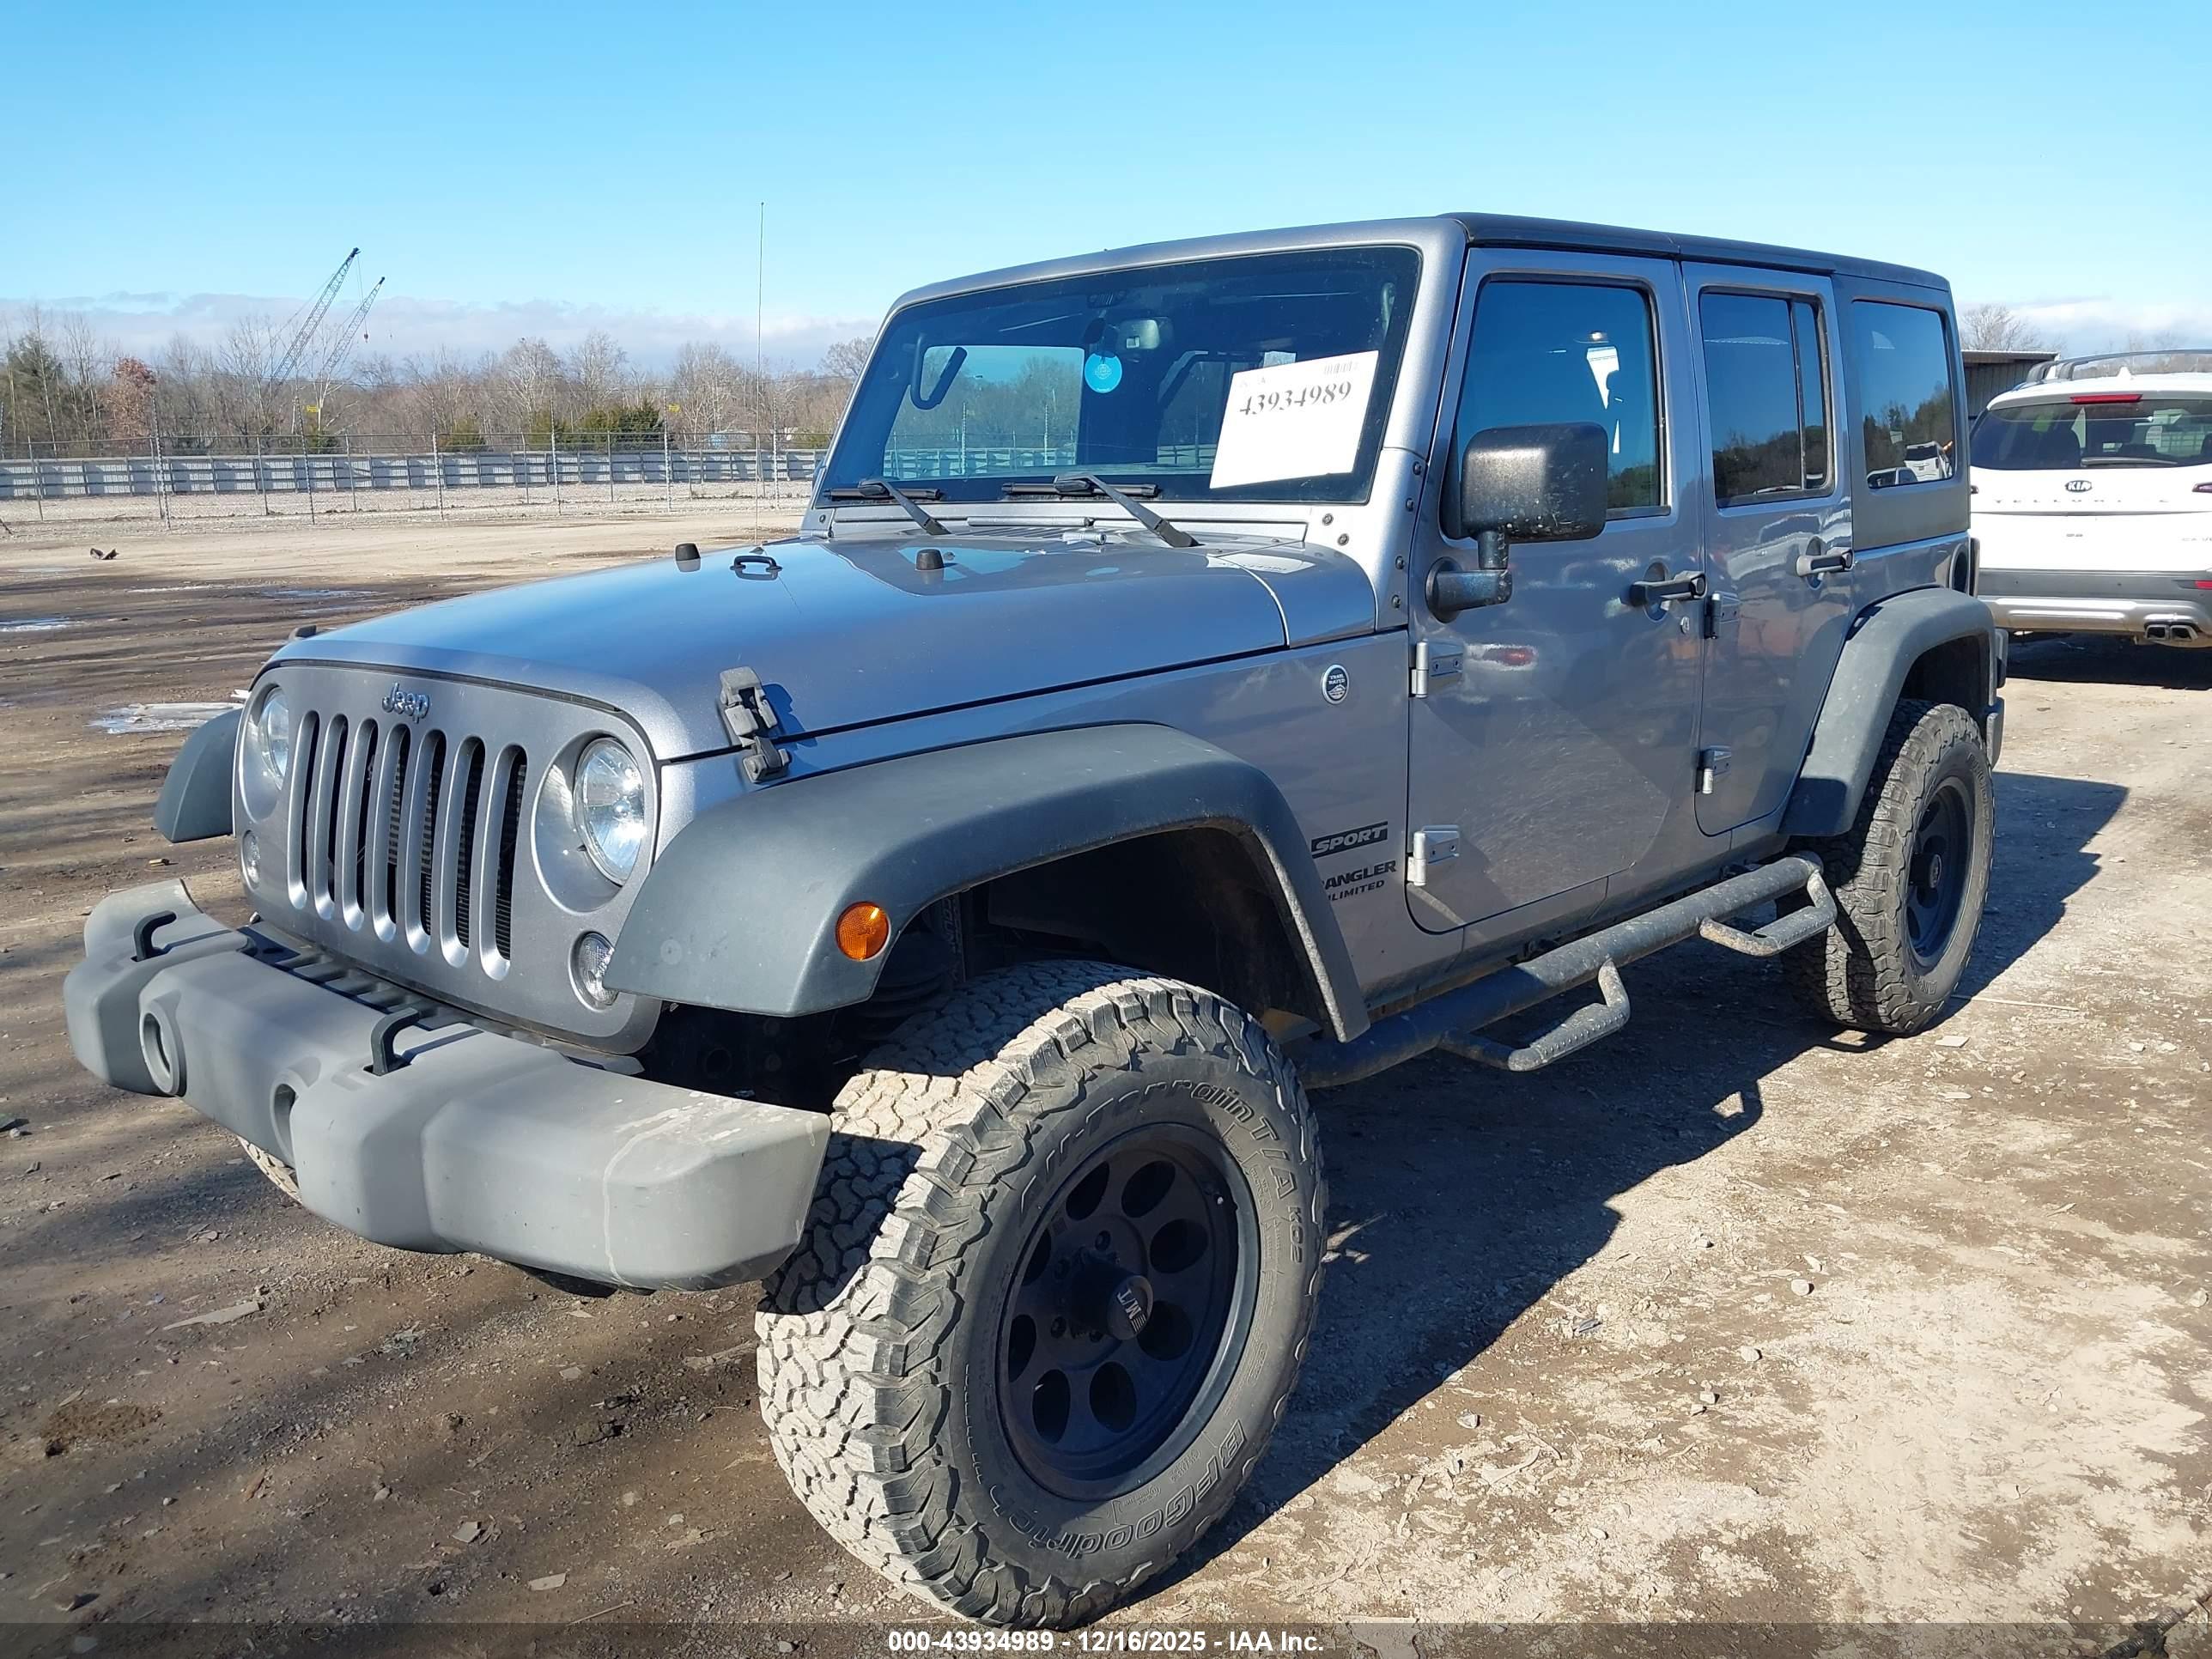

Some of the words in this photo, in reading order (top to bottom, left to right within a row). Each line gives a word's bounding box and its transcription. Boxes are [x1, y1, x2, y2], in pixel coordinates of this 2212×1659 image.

[1238, 380, 1352, 416] 43934989
[2066, 480, 2093, 492] KIA
[382, 682, 430, 724] Jeep
[1314, 823, 1389, 856] SPORT
[1320, 860, 1397, 890] ANGLER
[1328, 879, 1385, 902] LIMITED
